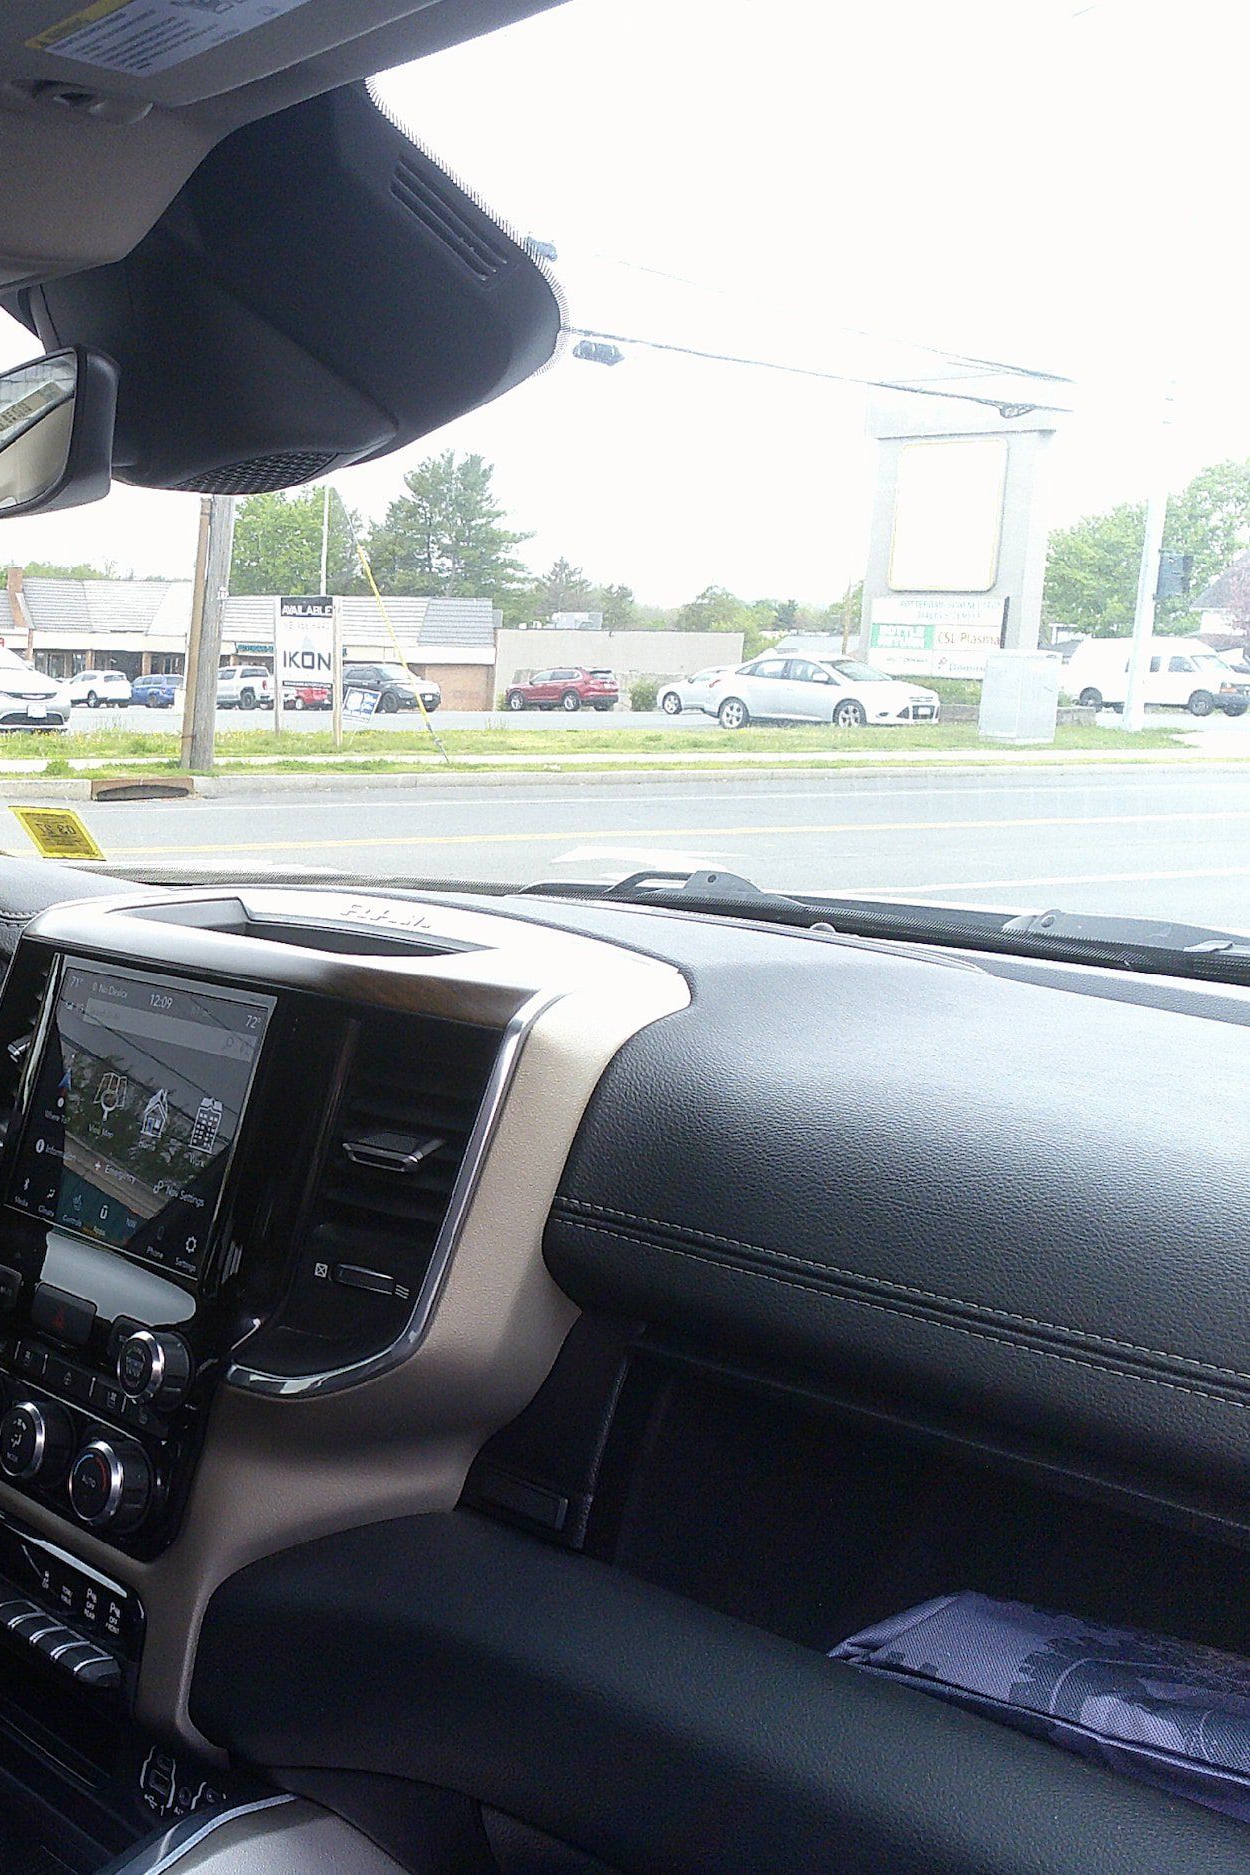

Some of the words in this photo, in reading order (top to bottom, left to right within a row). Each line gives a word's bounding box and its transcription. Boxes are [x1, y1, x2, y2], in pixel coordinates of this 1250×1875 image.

[281, 604, 332, 616] AVAILABLE
[937, 631, 956, 645] CSL
[960, 632, 1001, 646] Plasma
[282, 650, 332, 671] IKON
[150, 994, 174, 1010] 12:09
